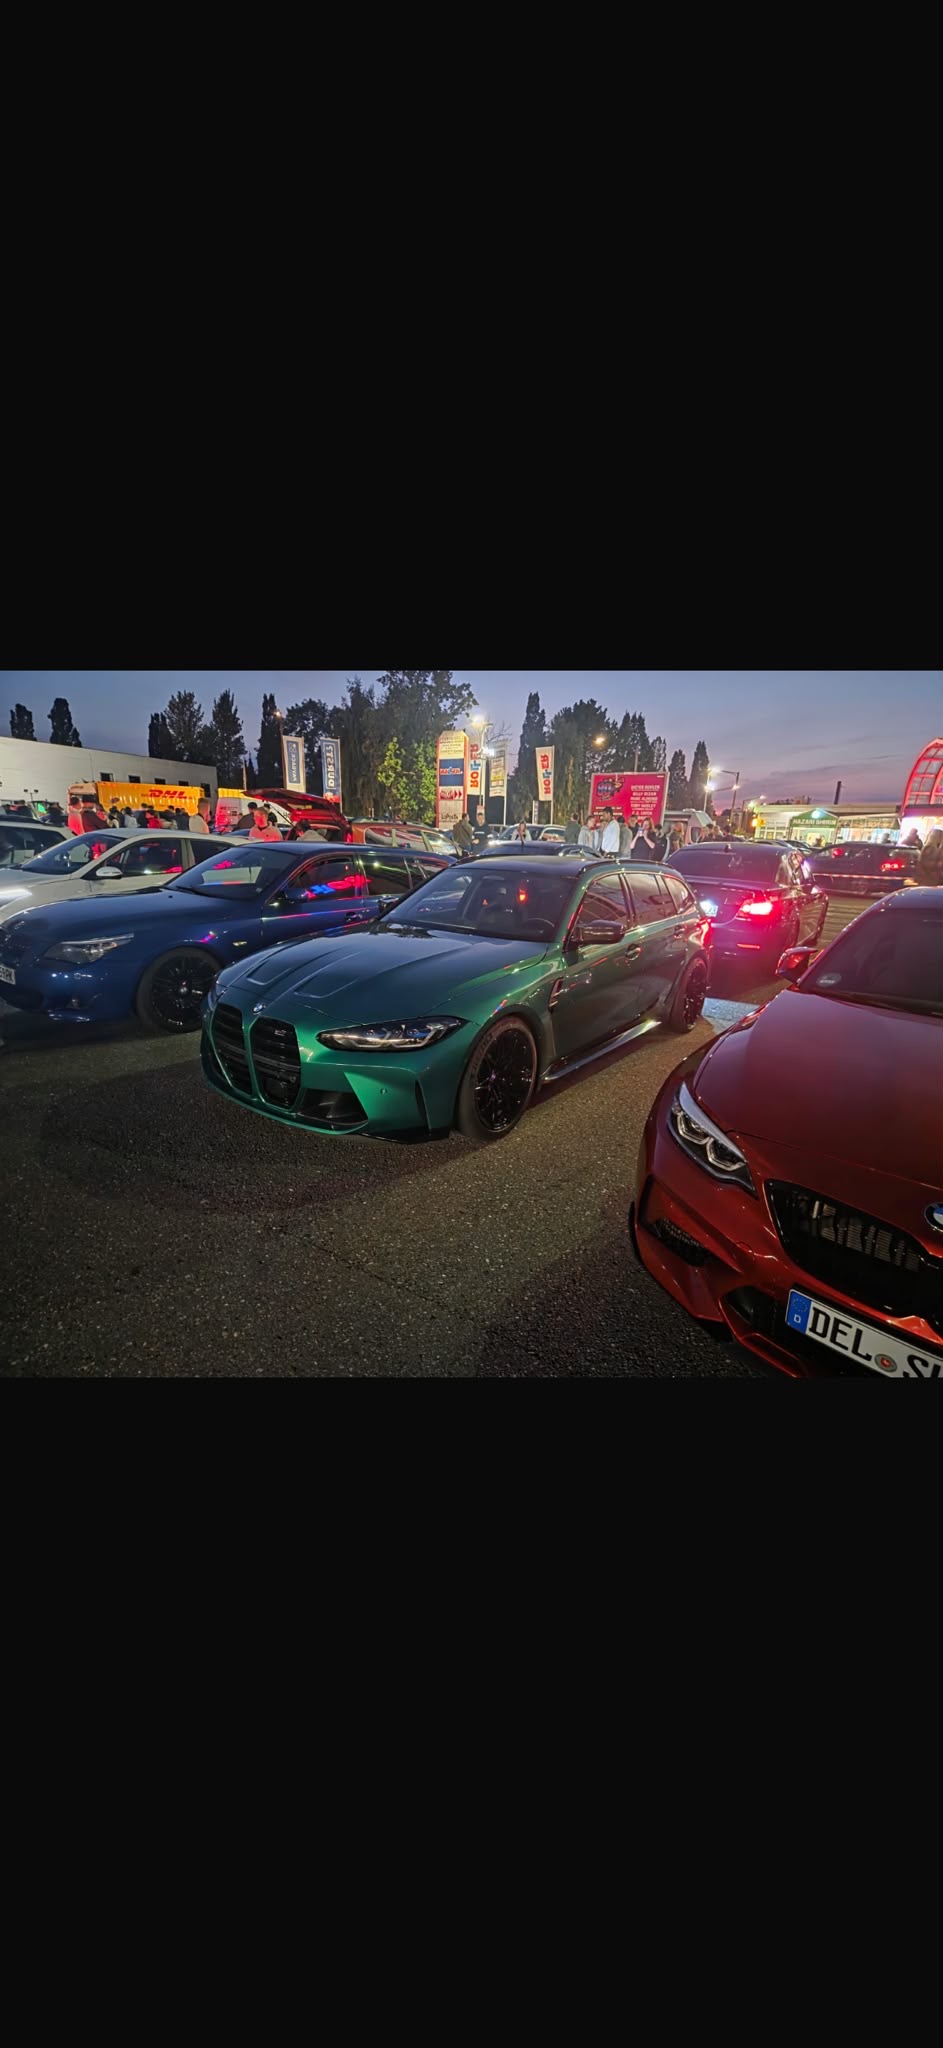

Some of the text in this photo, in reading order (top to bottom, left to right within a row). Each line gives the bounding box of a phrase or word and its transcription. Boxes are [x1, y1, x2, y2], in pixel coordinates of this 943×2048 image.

[149, 789, 187, 799] DHL
[793, 1313, 802, 1324] D
[809, 1307, 872, 1361] DEL
